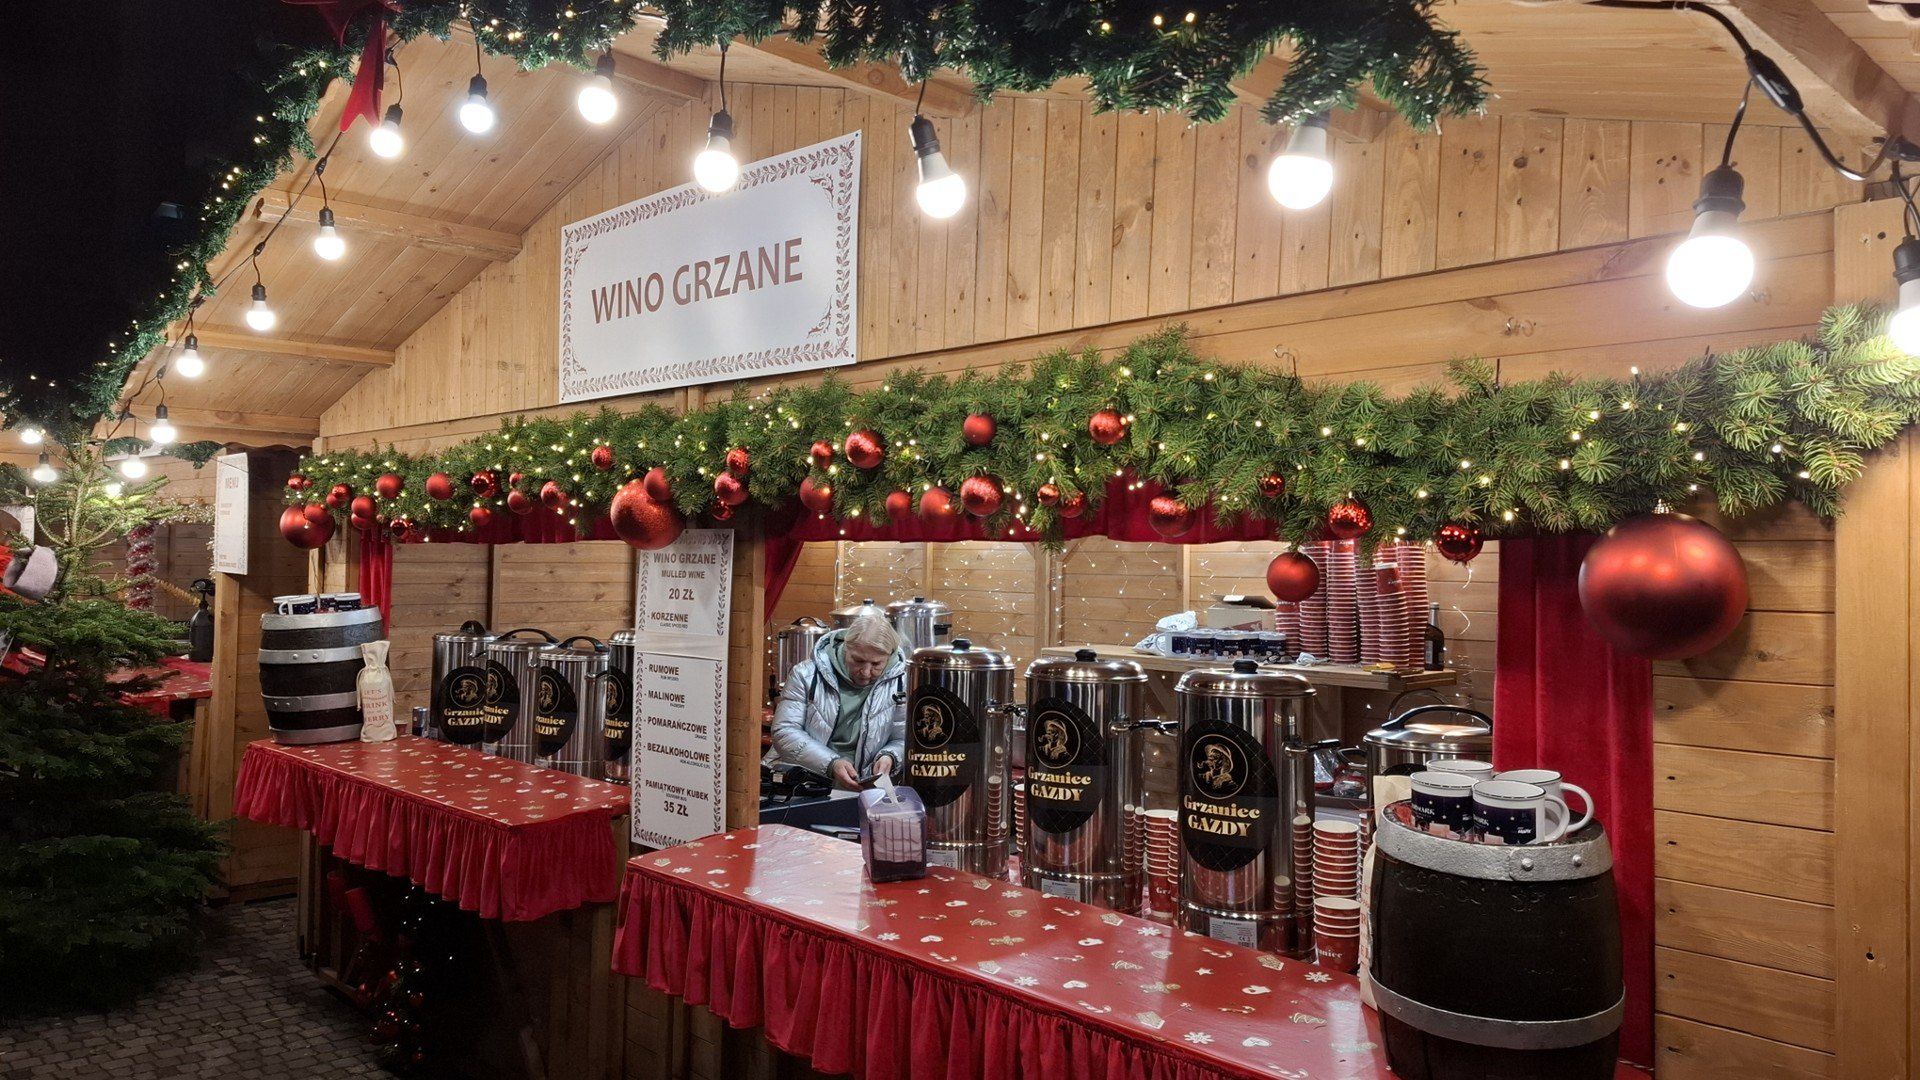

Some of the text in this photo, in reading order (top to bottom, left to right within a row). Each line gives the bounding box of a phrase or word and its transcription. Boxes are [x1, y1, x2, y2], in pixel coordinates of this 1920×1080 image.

[591, 237, 803, 324] WINO GRZANE
[653, 553, 716, 565] WINO GRZANE
[661, 570, 705, 579] MULLED WINE
[668, 588, 695, 601] 20 ZŁ
[651, 611, 688, 622] KORZENNE
[648, 664, 679, 676] RUMOWE
[648, 690, 685, 703] MALINOWE
[647, 716, 707, 734] POMARAŃCZOWE
[647, 742, 710, 762] BEZALKOHOLOWE
[908, 749, 966, 762] Grzaniec
[911, 764, 960, 777] GAZDY
[1028, 766, 1092, 785] Grzaniec
[686, 789, 709, 801] KUBEK
[1030, 783, 1084, 801] GAZDY
[664, 801, 689, 817] 35 ZŁ
[1183, 794, 1260, 819] Grzaniec
[1188, 814, 1252, 837] GAZDY
